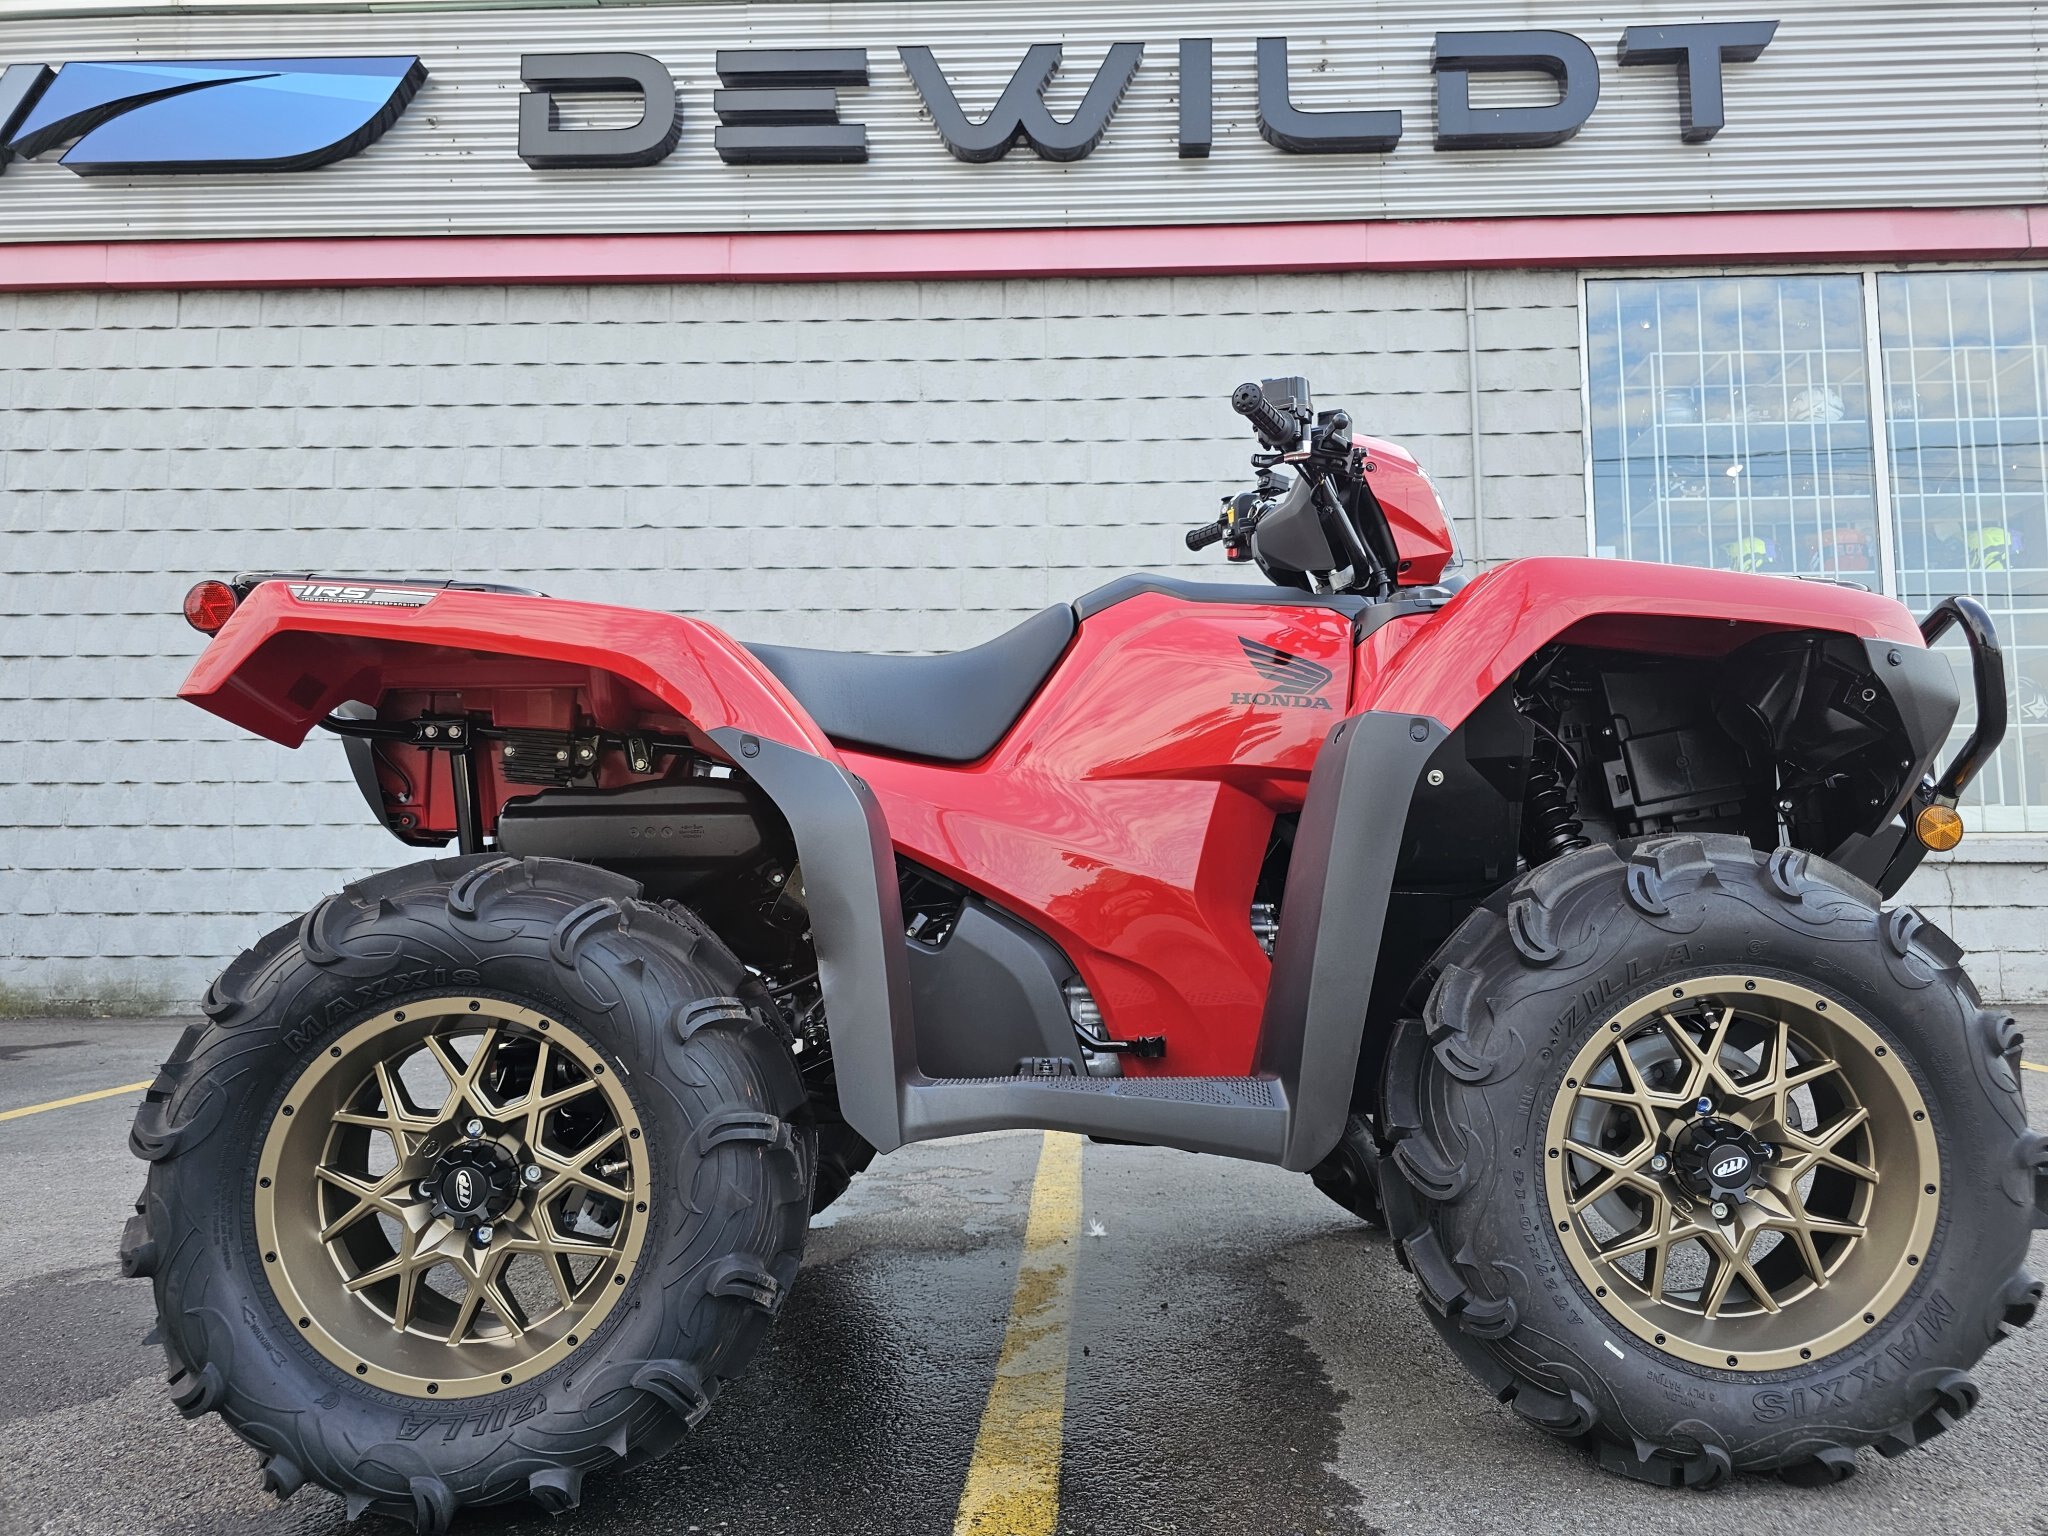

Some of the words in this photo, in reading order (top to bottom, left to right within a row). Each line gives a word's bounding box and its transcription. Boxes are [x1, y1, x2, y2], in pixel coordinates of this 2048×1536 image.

[518, 20, 1778, 168] DEWILDT
[304, 586, 371, 598] IRS
[1230, 692, 1333, 710] HONDA
[282, 967, 481, 1053] MAXXIS
[1717, 1158, 1743, 1176] ITP
[459, 1174, 471, 1204] ITP
[1752, 1289, 1956, 1424] MAXXIS
[396, 1394, 548, 1442] ZILLA
